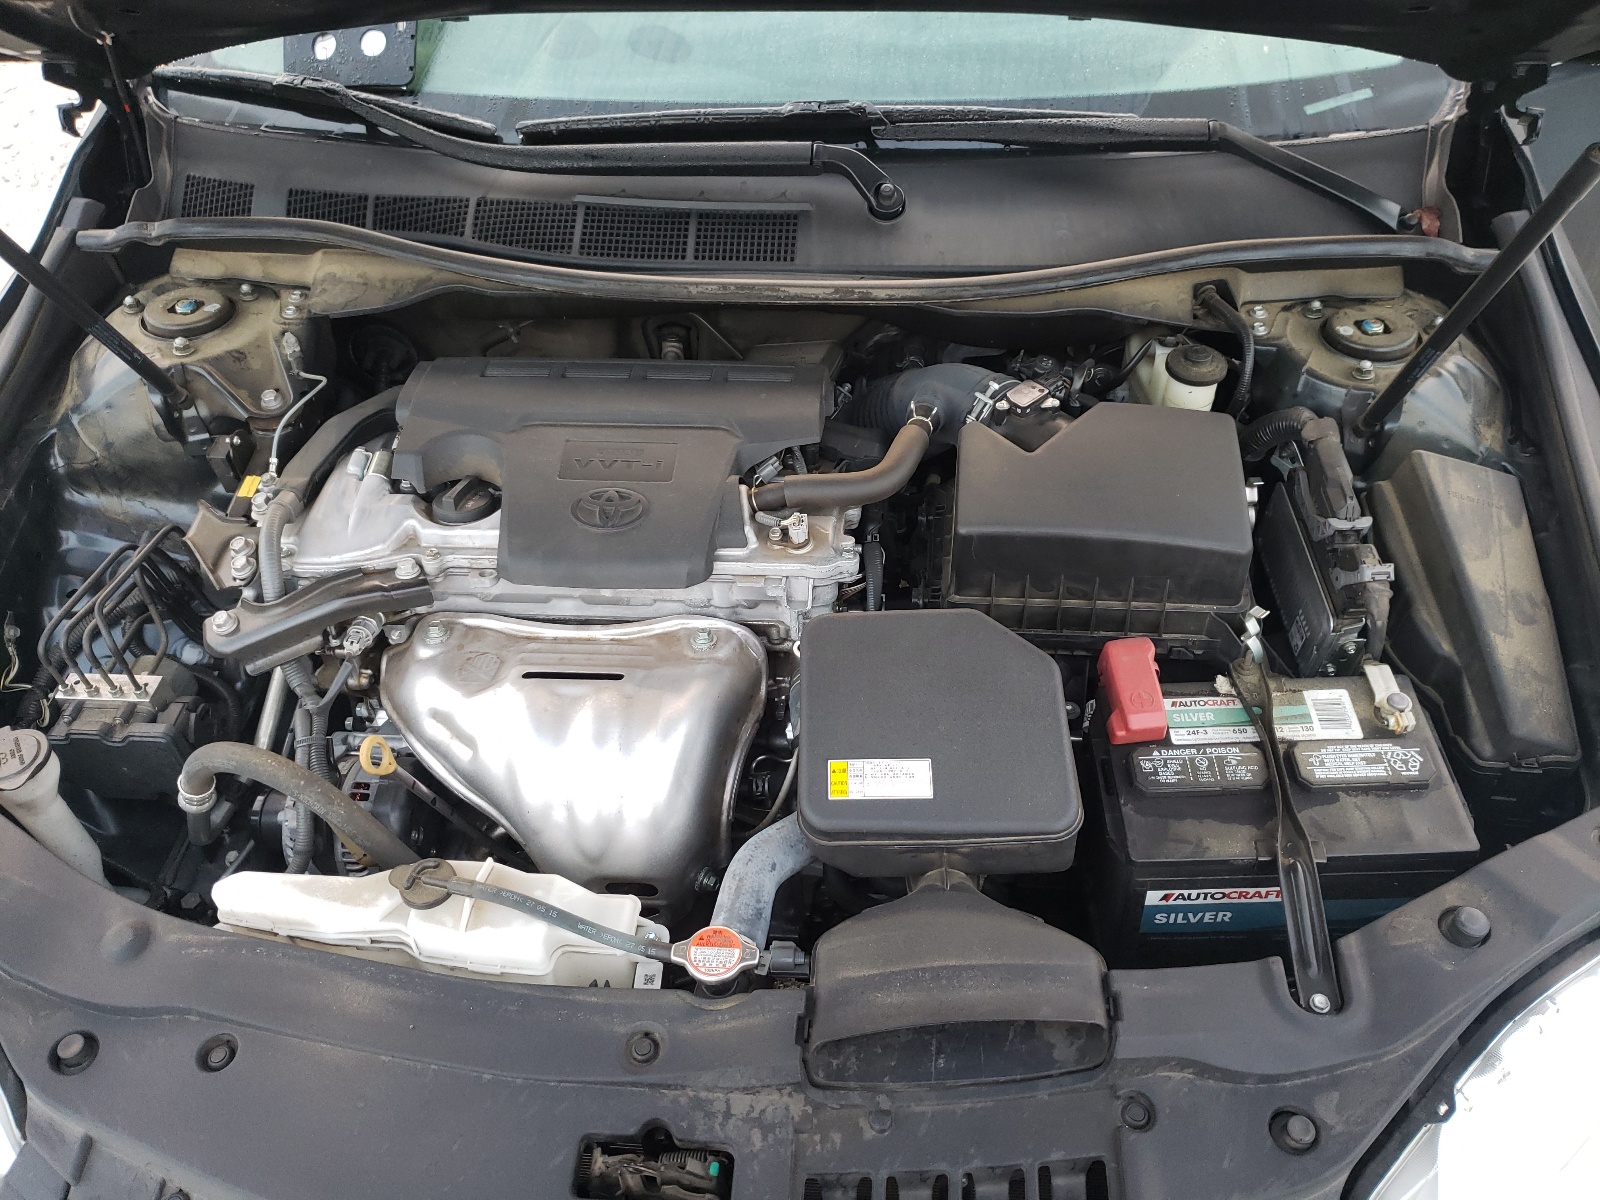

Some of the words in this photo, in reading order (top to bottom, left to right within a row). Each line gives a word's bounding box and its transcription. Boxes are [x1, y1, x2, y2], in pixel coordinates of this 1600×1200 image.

[1178, 699, 1237, 708] AUTOCRAFT
[1172, 712, 1215, 722] SILVER
[1161, 748, 1198, 756] DANGER
[1153, 911, 1233, 924] SILVER
